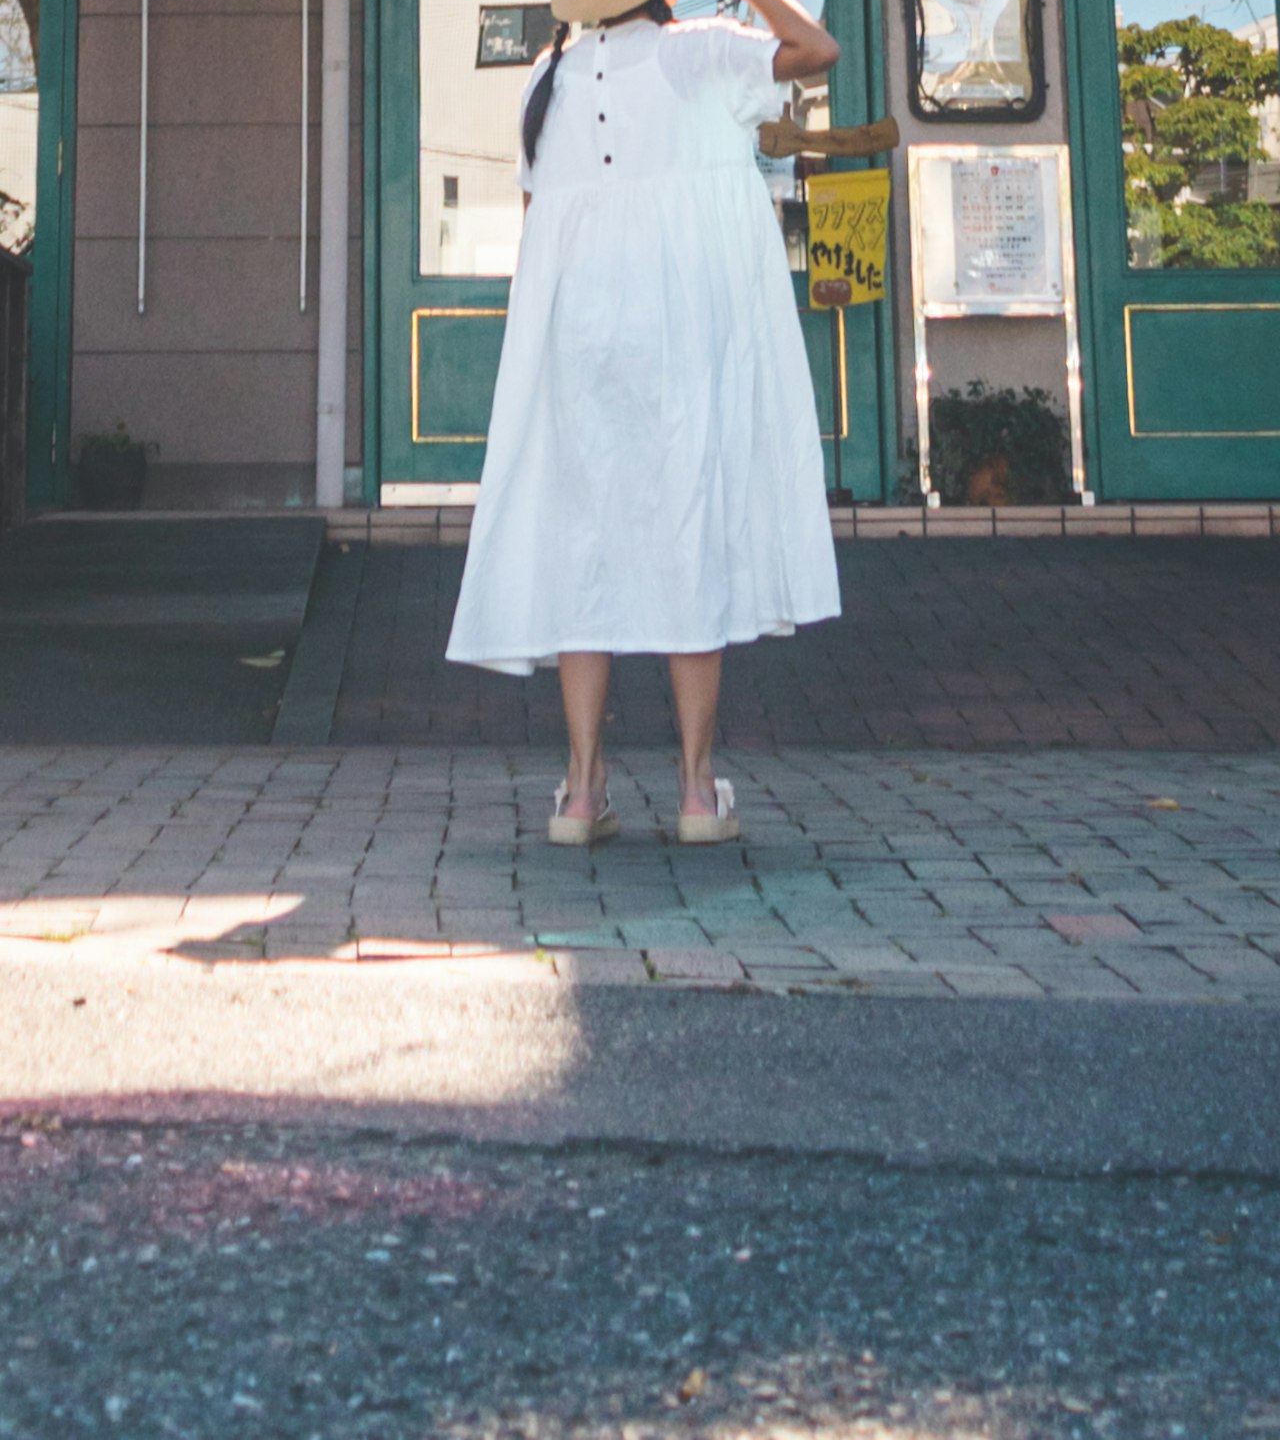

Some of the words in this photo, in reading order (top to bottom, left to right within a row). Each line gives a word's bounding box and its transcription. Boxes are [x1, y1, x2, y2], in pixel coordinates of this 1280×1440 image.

[812, 195, 885, 230] フランス
[811, 240, 882, 291] やけました
